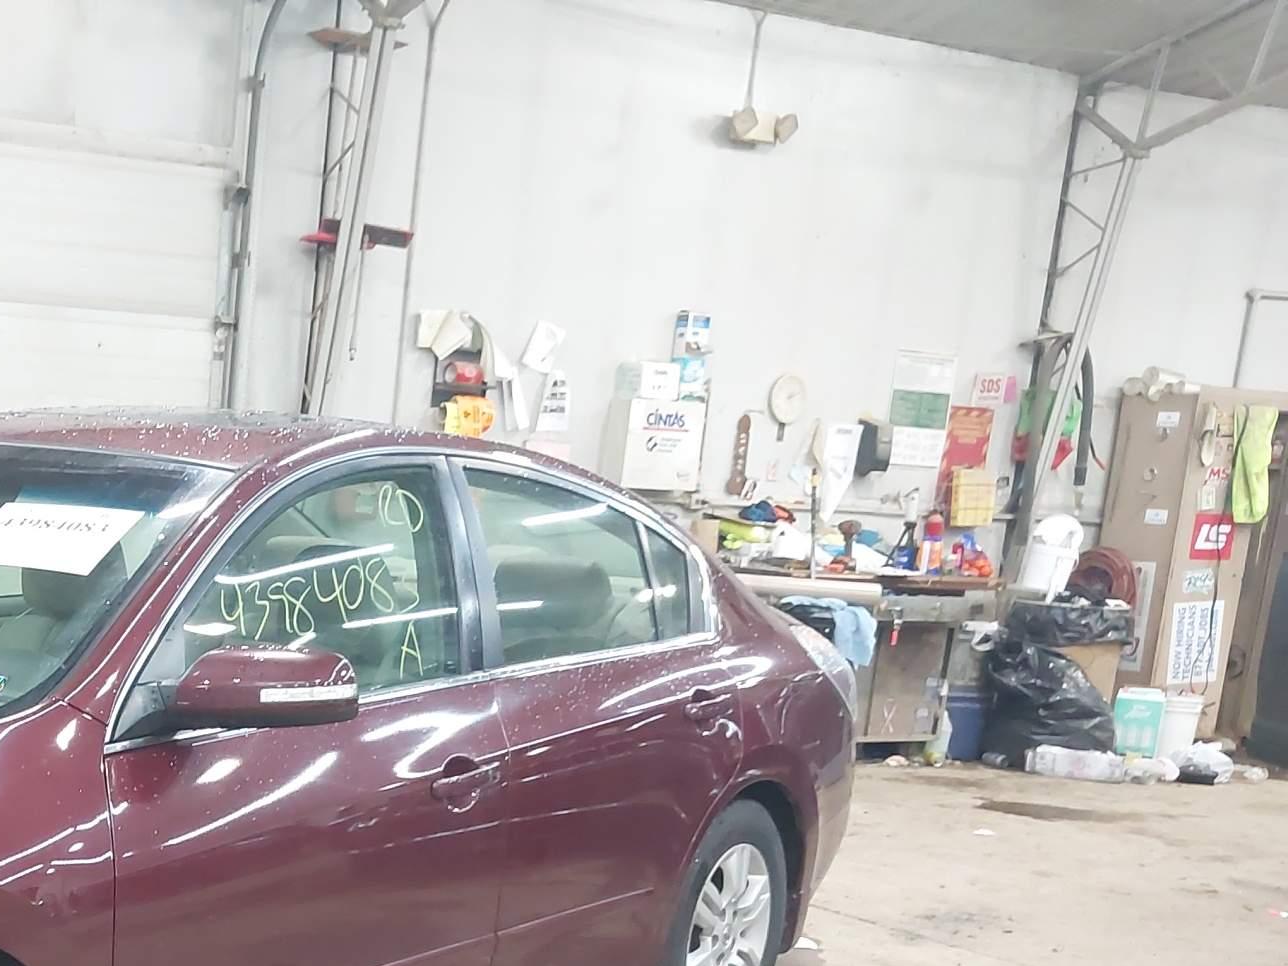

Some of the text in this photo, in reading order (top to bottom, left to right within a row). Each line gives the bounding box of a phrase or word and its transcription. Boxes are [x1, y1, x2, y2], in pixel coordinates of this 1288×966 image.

[979, 378, 1002, 394] SDS
[220, 556, 420, 641] 43984083
[400, 619, 423, 680] A
